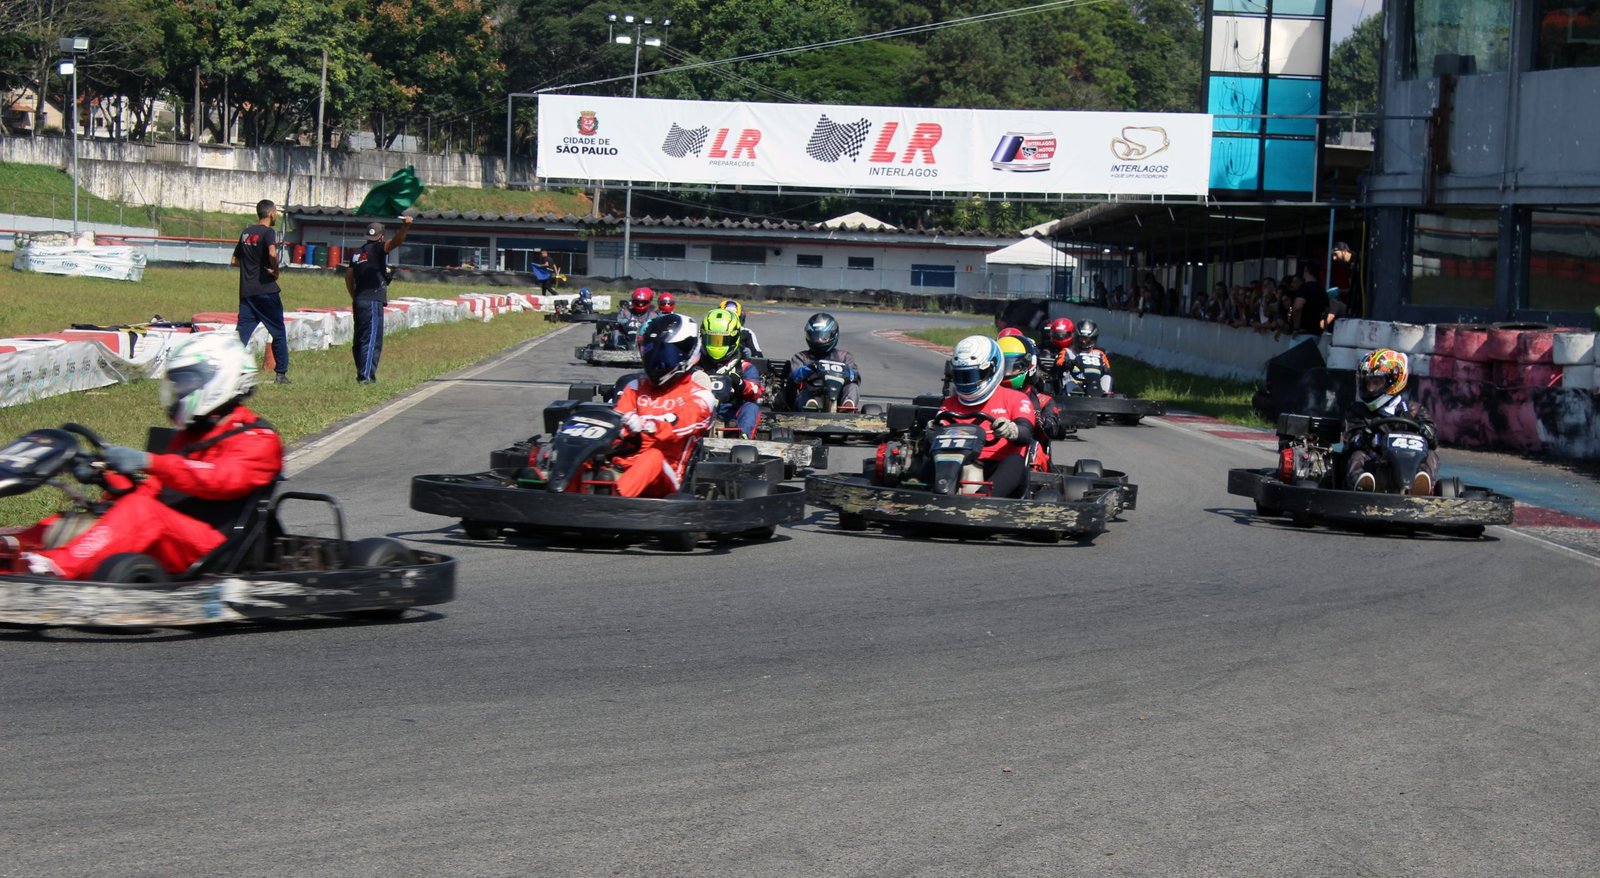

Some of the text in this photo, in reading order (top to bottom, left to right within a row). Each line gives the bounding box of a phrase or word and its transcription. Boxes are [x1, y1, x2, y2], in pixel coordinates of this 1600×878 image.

[563, 136, 597, 145] CIDADE
[707, 128, 761, 159] LR
[867, 121, 943, 164] LR
[556, 144, 618, 155] SÃO PAULO
[869, 166, 938, 178] INTERLAGOS
[1110, 164, 1169, 173] INTERLAGOS
[821, 363, 843, 372] 10
[562, 423, 608, 439] 40
[938, 438, 967, 448] 11
[1391, 437, 1424, 451] 42
